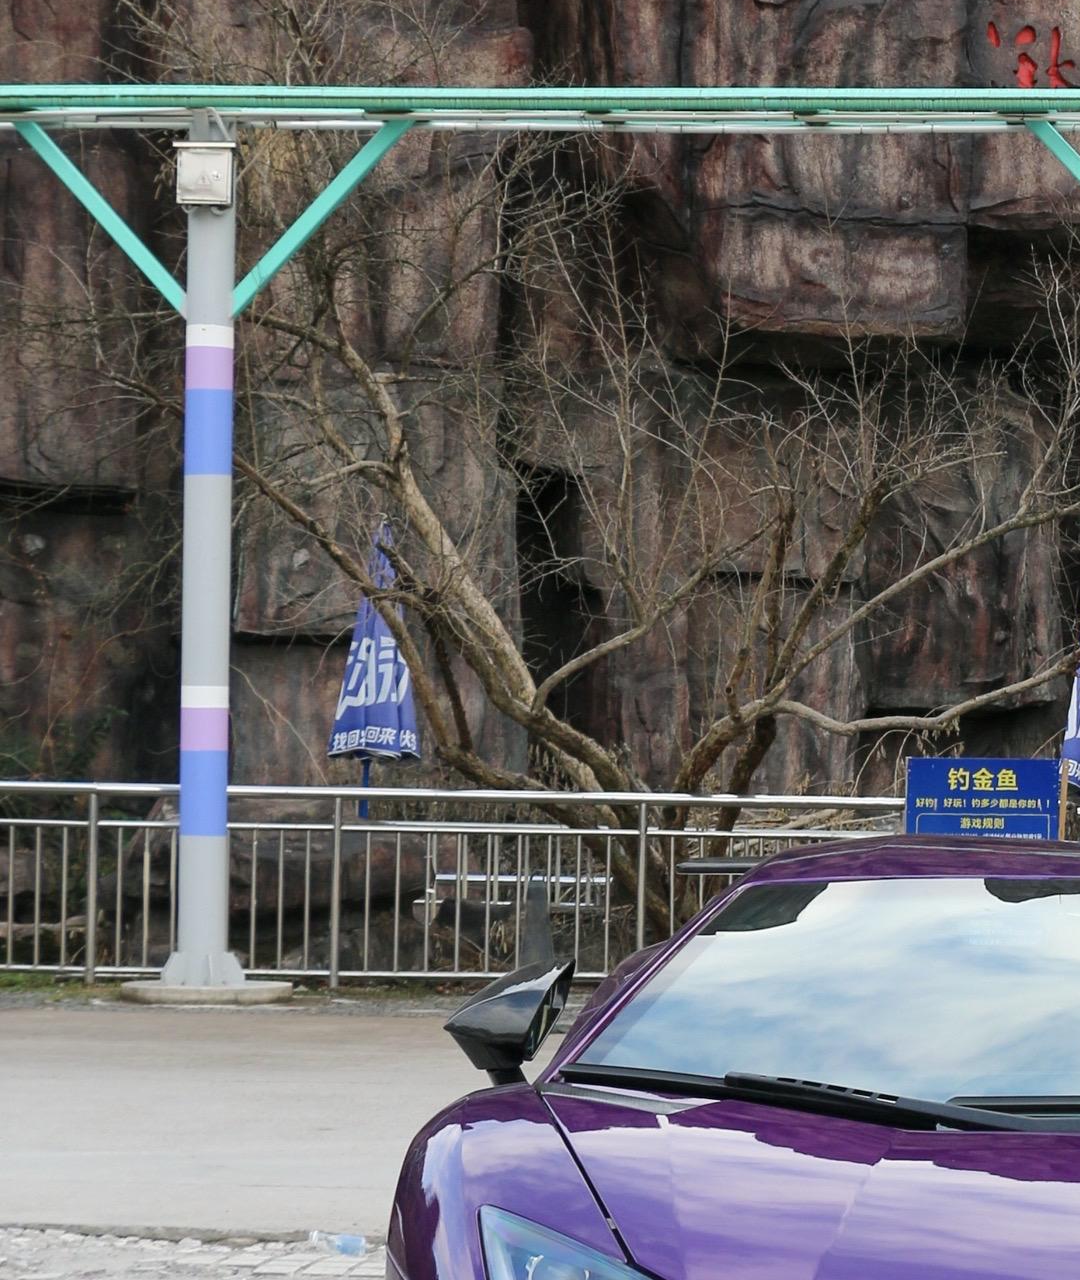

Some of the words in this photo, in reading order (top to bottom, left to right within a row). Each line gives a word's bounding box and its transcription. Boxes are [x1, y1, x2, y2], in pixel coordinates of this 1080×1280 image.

[947, 767, 1019, 791] 钓金鱼
[960, 817, 1005, 830] 游戏规则
